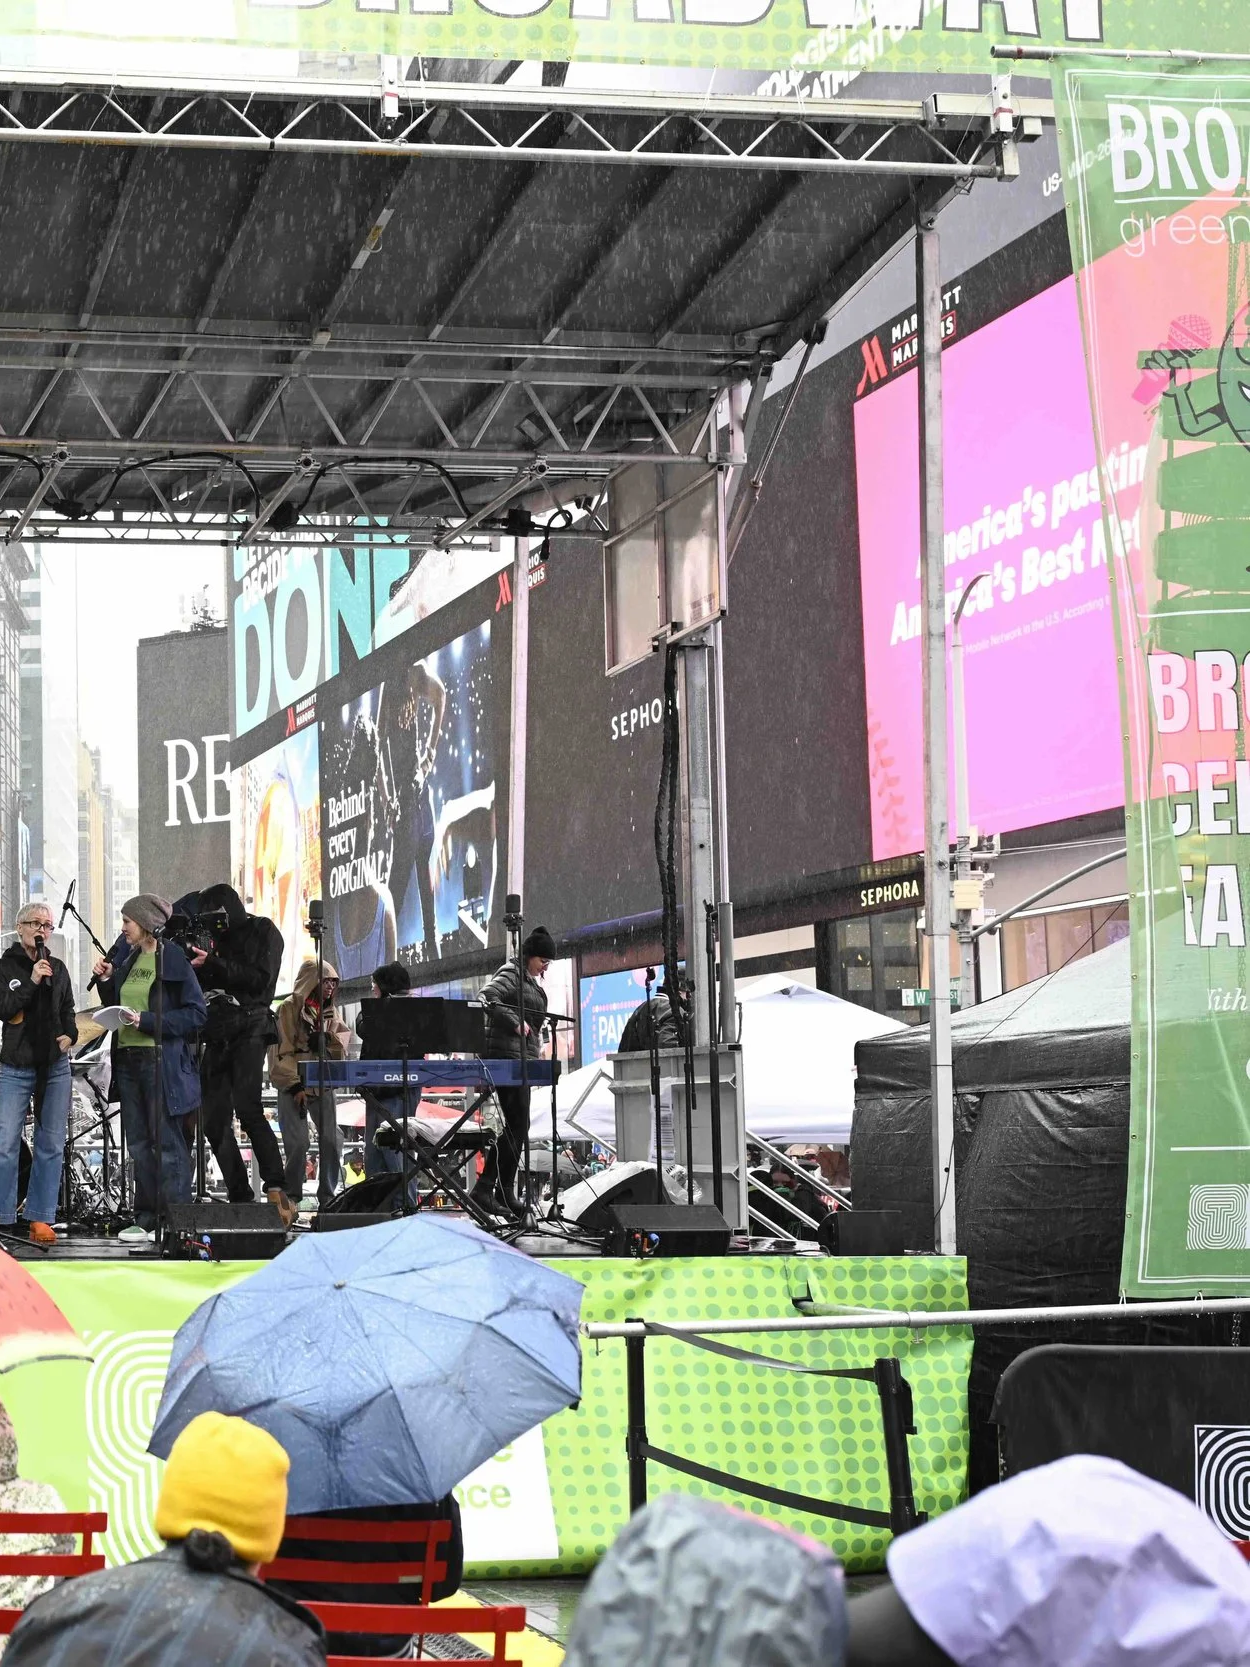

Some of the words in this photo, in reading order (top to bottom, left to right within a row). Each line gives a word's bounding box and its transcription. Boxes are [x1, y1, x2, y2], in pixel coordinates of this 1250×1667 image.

[1107, 103, 1250, 192] BRO
[1120, 213, 1250, 258] green
[1021, 527, 1086, 596] Best
[1147, 649, 1250, 735] BR
[611, 694, 672, 740] SEPHO
[328, 780, 366, 828] Behind
[328, 827, 357, 861] every
[860, 879, 919, 907] SEPHORA
[915, 991, 926, 1004] W
